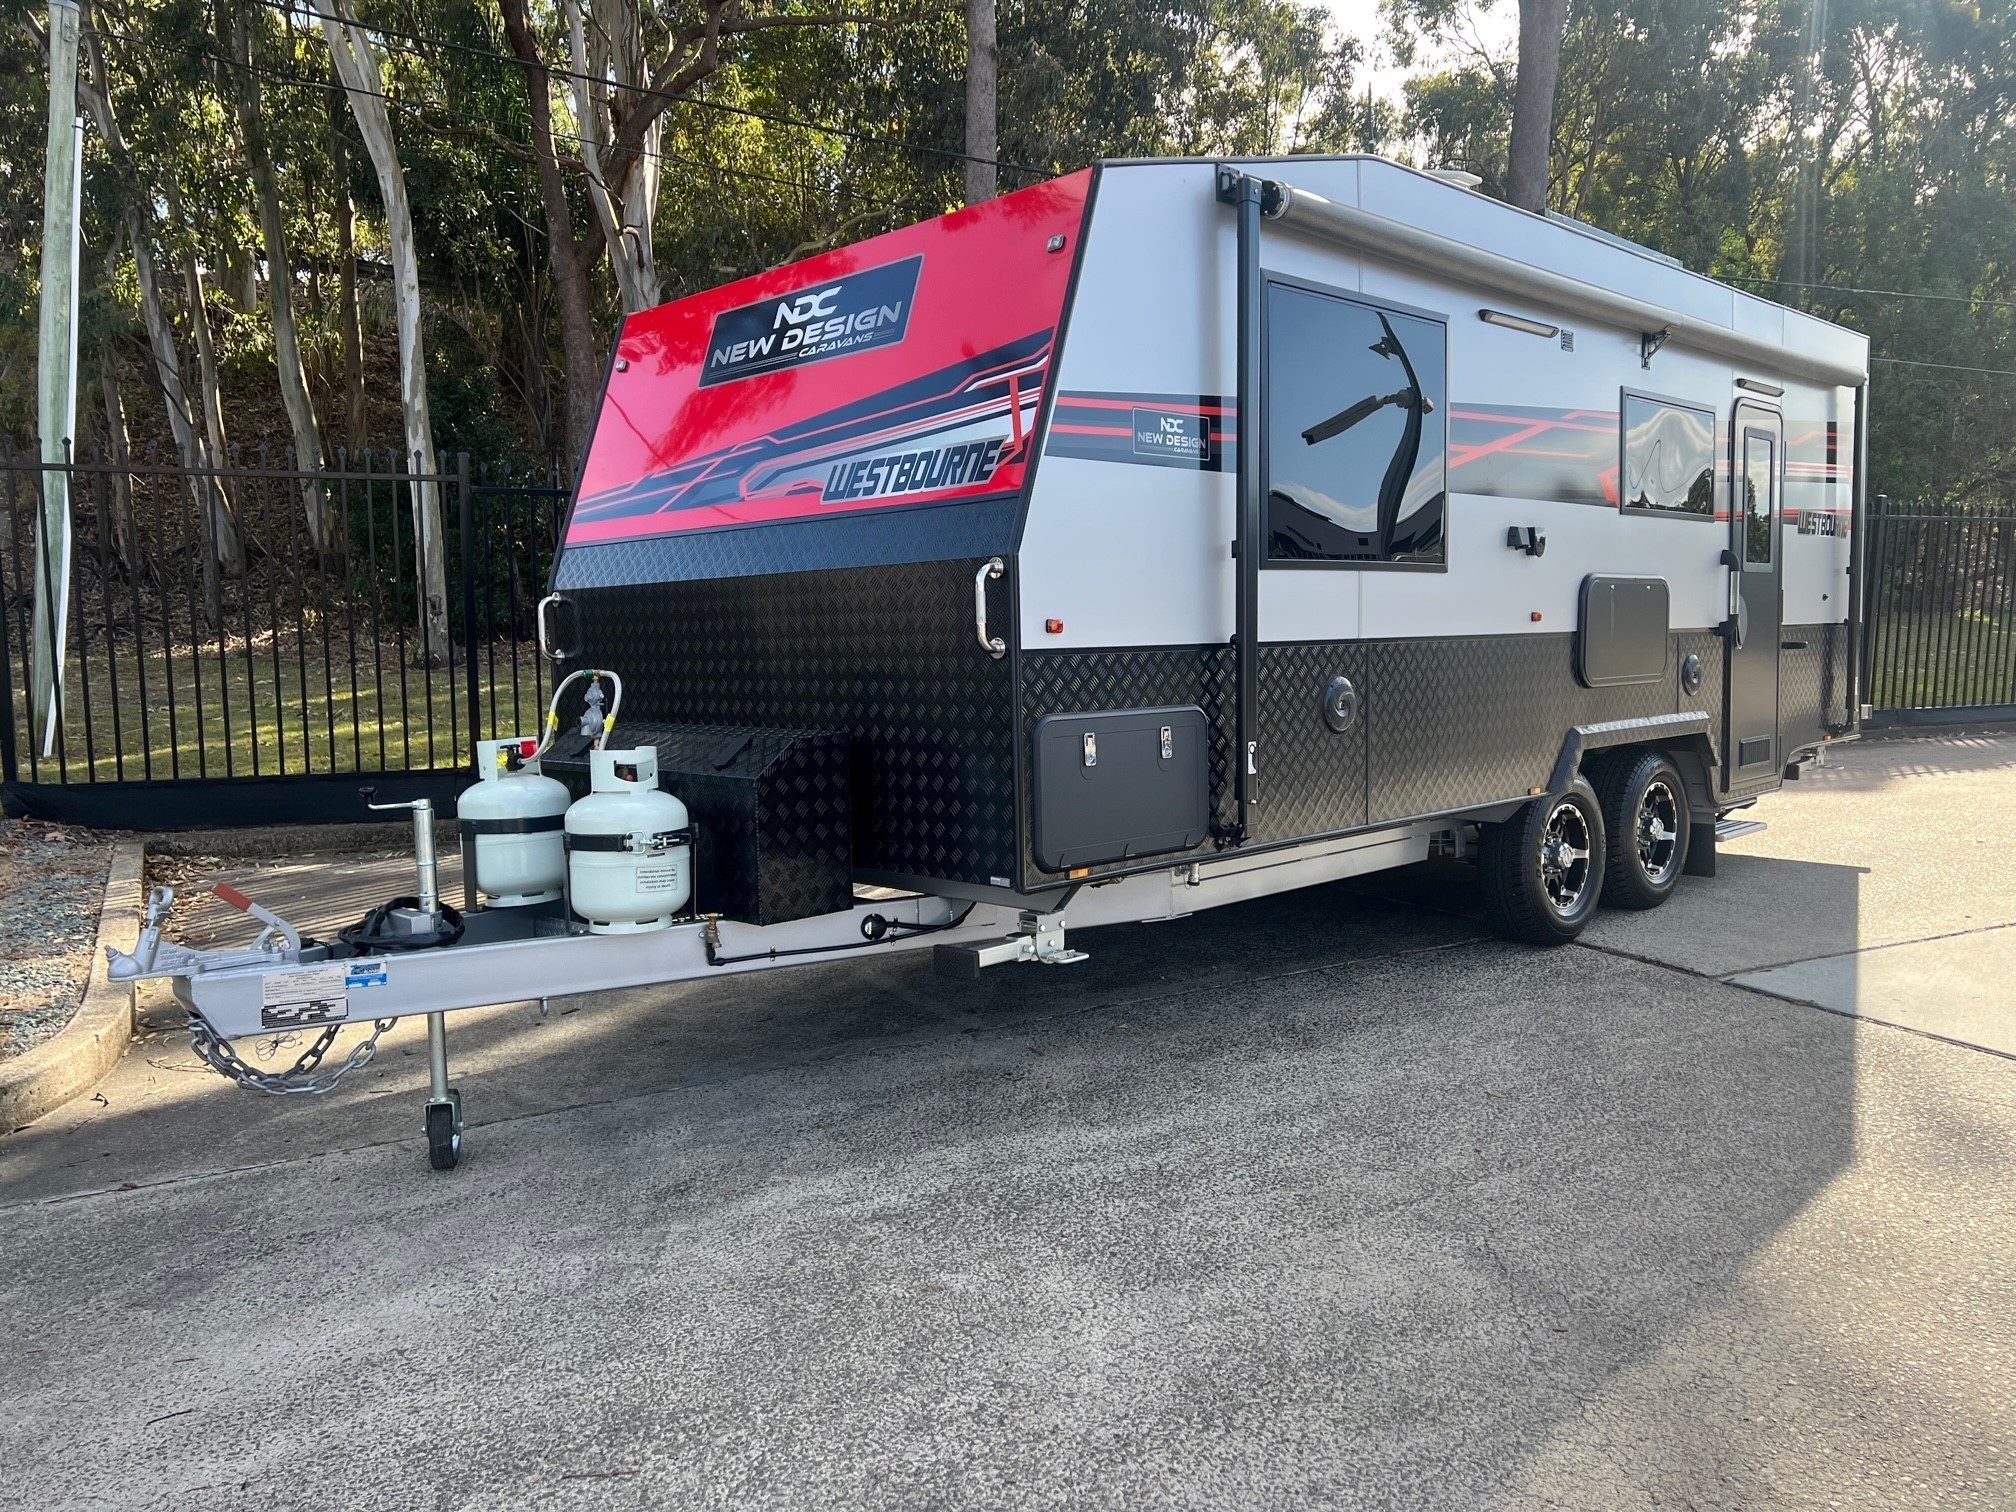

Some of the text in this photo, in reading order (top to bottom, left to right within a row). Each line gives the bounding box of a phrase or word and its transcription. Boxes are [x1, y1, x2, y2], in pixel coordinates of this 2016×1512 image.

[772, 285, 843, 330] NDC
[710, 300, 903, 368] NEW DESIGN
[798, 331, 874, 358] CARAVANS
[1160, 416, 1185, 434] NDC
[1137, 431, 1206, 450] NEW DESIGN
[1173, 447, 1199, 455] CARAVANS
[822, 438, 1006, 501] WESTBOURNE
